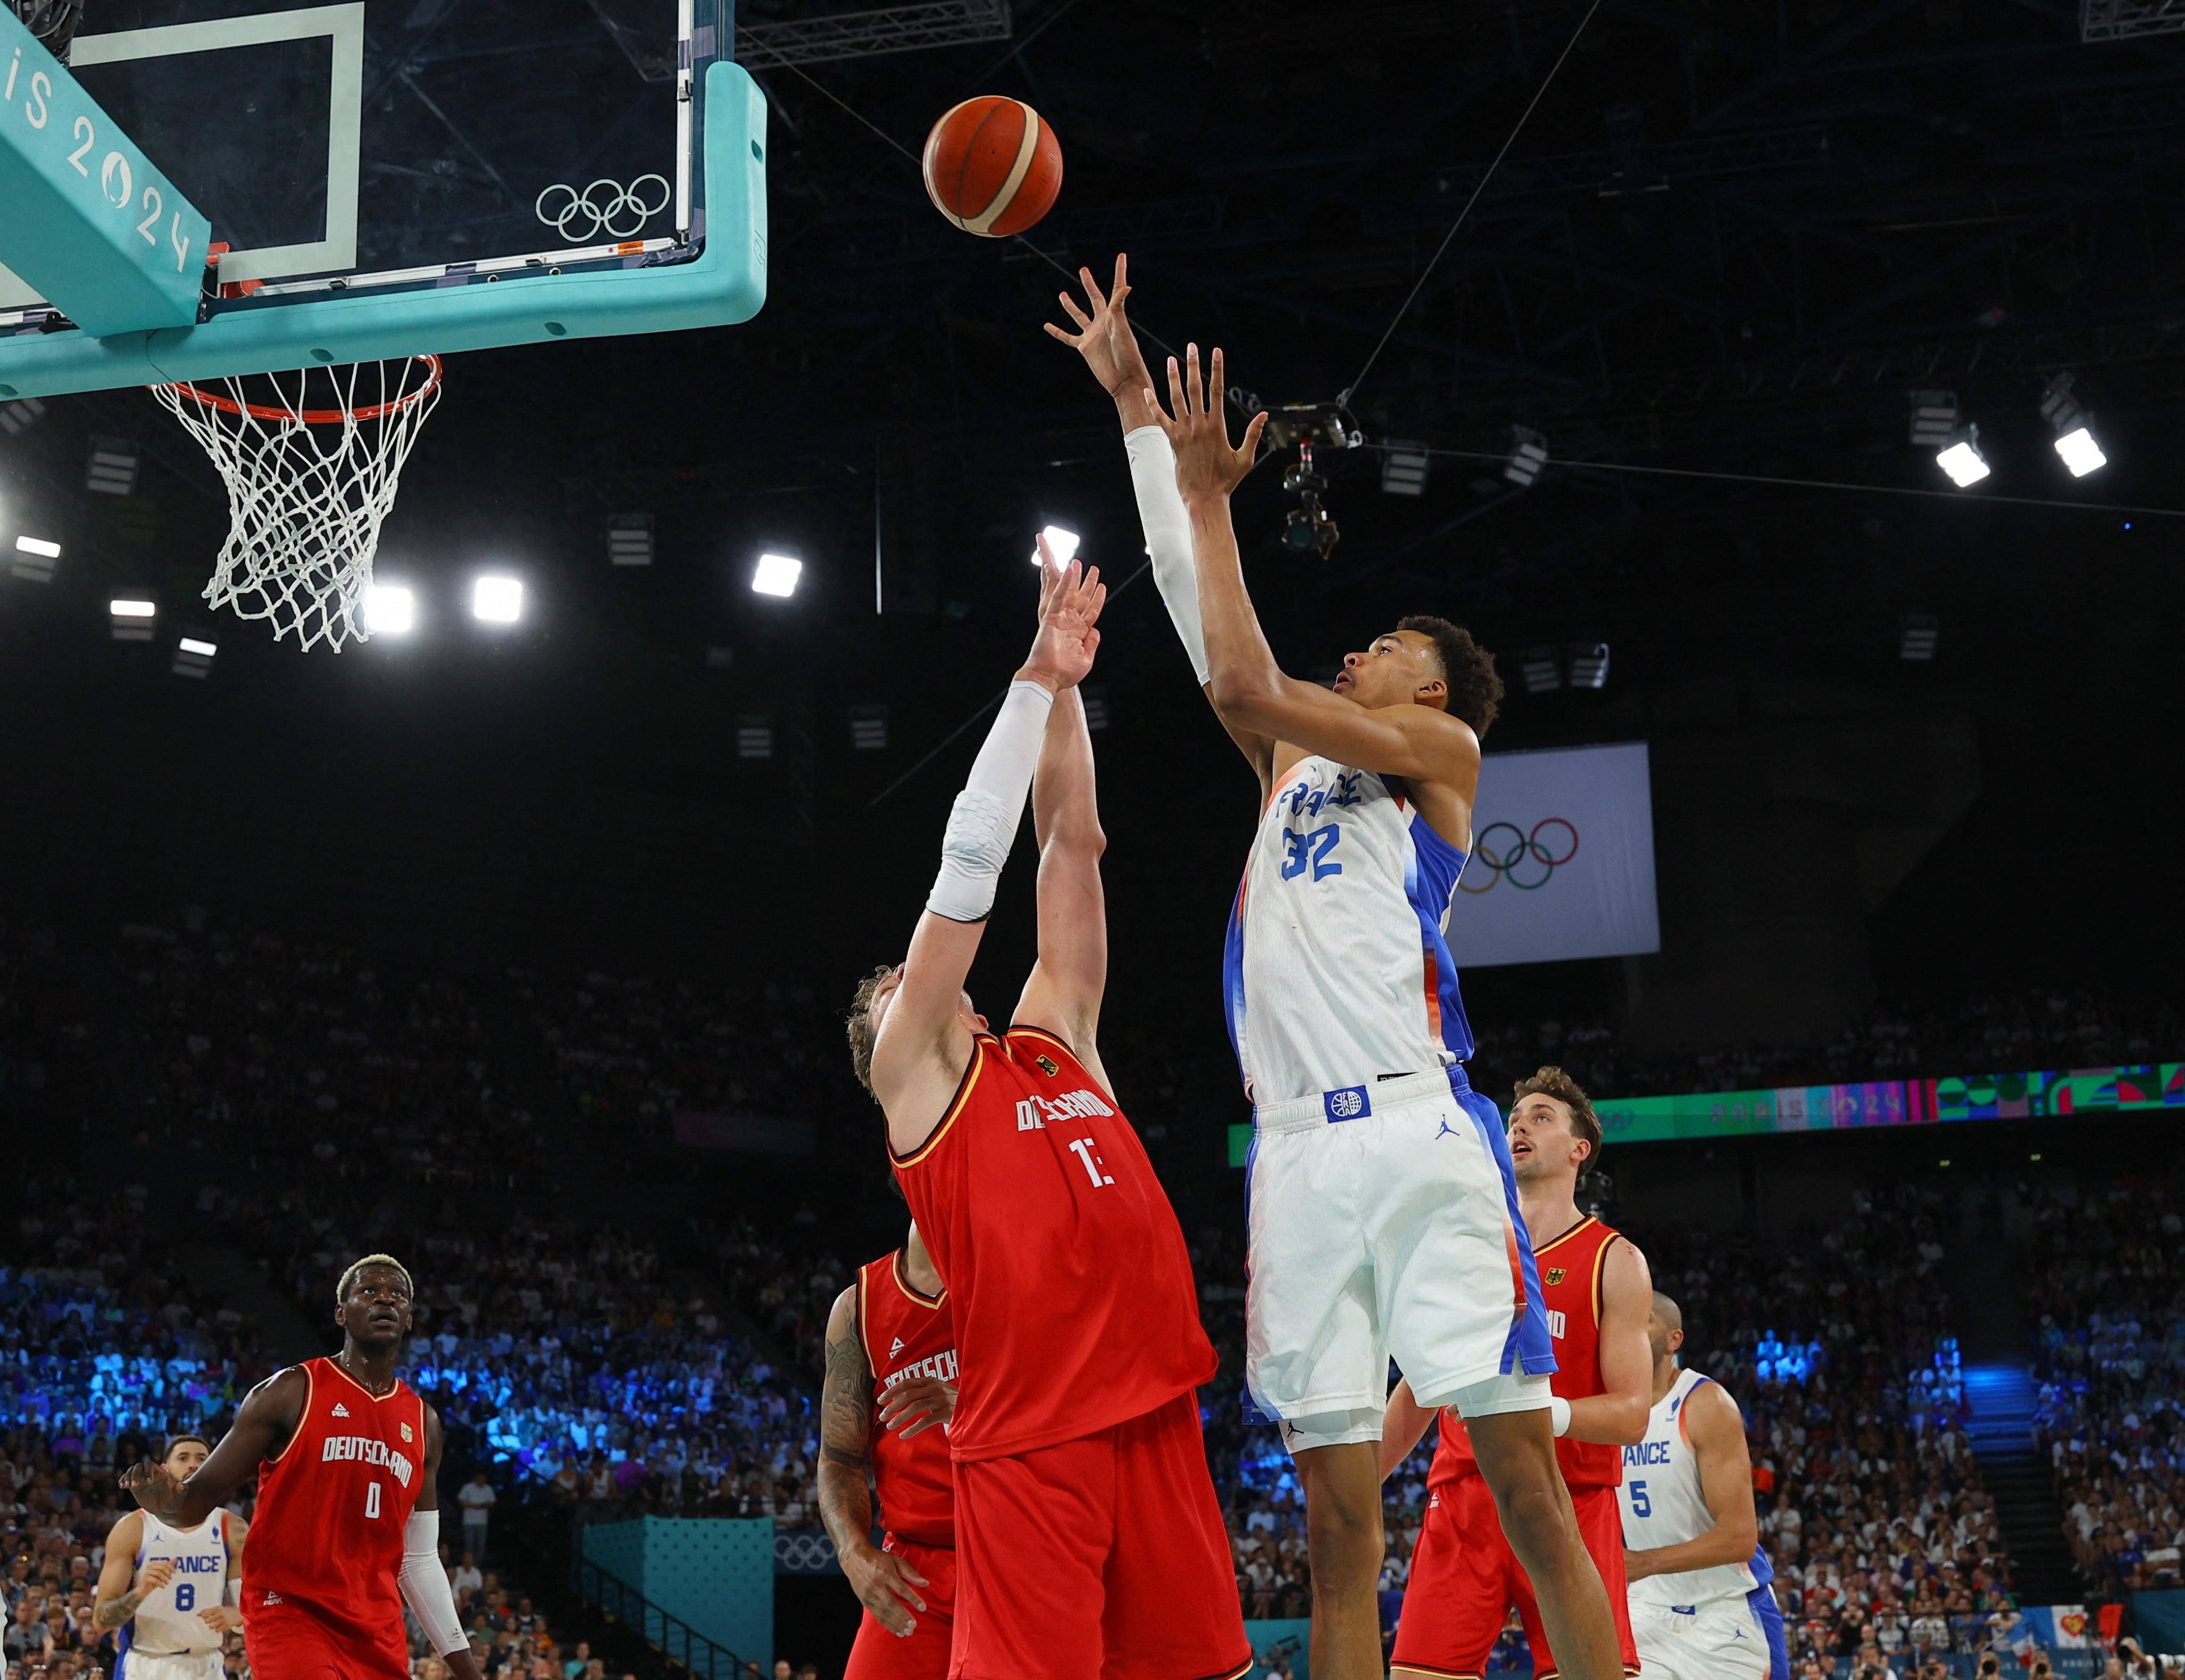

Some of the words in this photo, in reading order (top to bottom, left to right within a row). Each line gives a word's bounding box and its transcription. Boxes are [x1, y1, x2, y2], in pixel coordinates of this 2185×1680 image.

[67, 116, 190, 273] 2024
[1281, 823, 1342, 882] 32
[365, 1482, 381, 1519] 0
[1629, 1481, 1652, 1517] 5
[176, 1583, 195, 1611] 8
